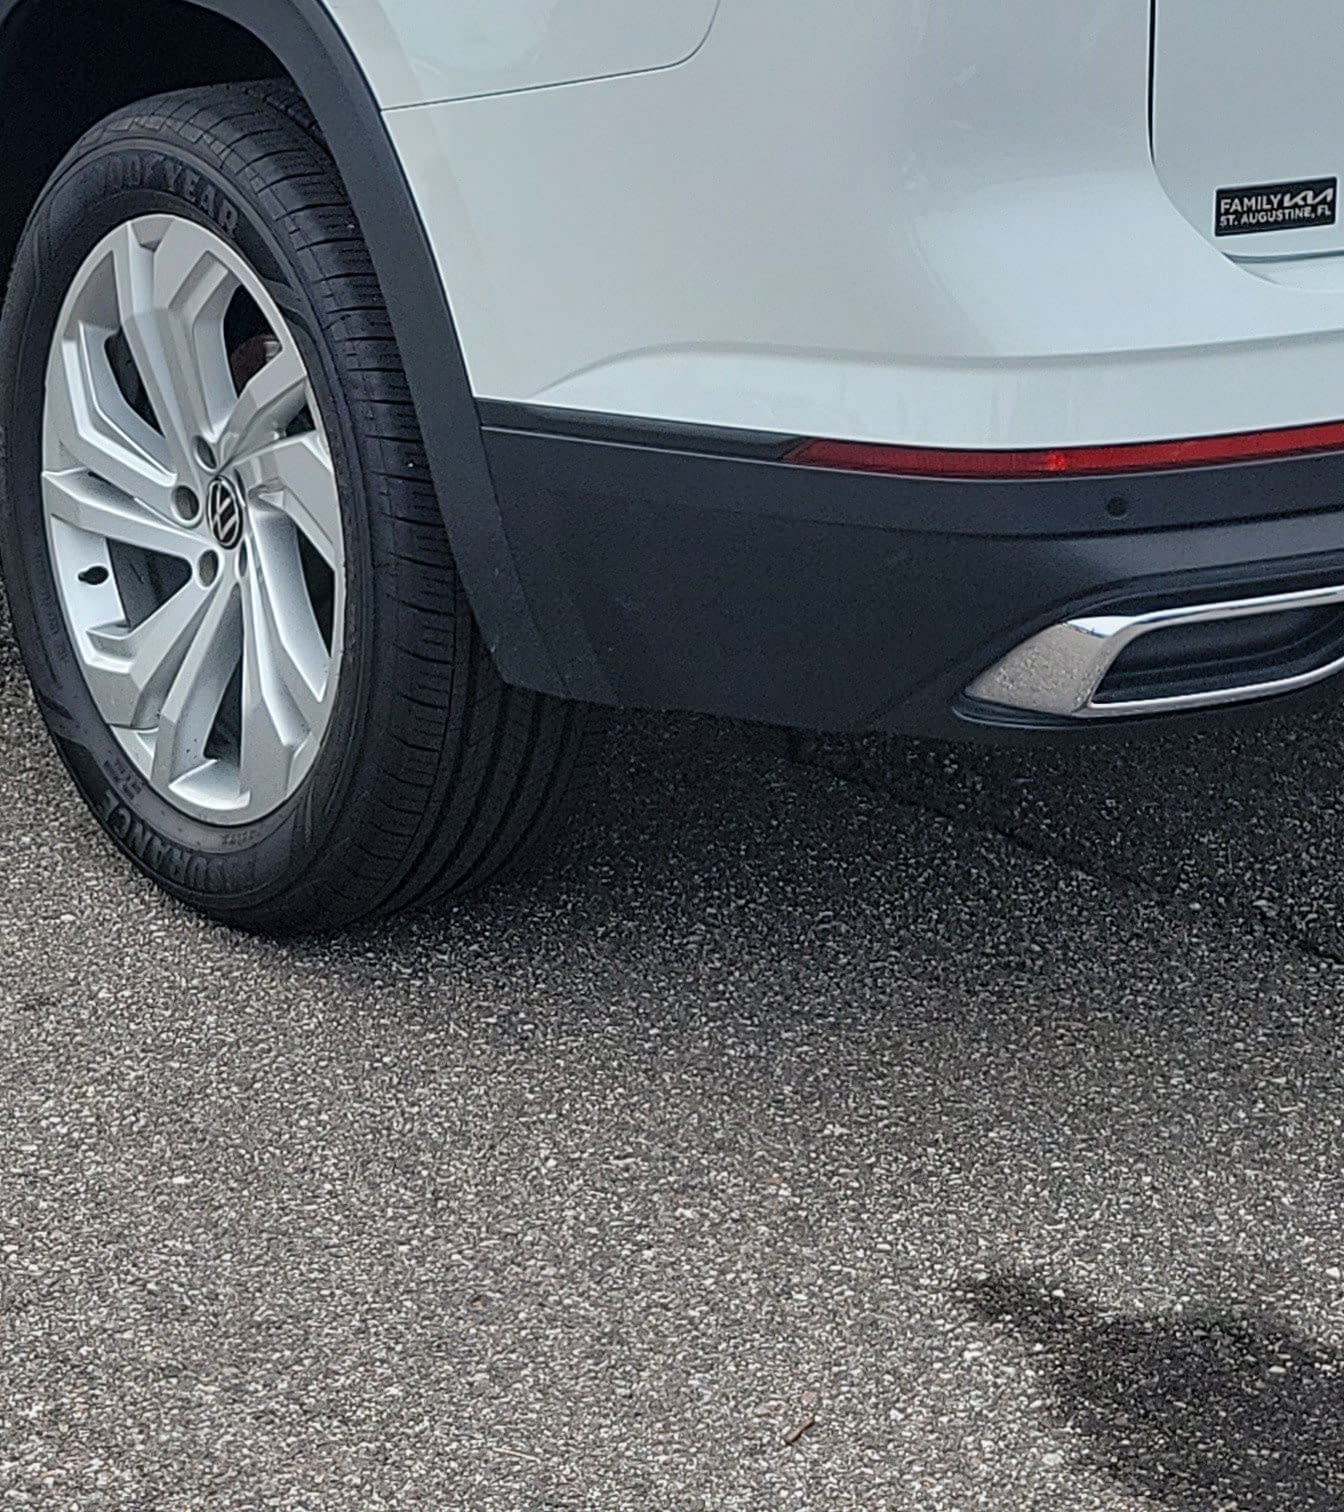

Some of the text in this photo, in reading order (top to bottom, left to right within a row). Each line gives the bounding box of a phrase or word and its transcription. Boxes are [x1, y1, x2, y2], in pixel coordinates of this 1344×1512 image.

[1220, 192, 1282, 214] FAMILY
[1219, 204, 1332, 227] ST. AUGUSTINE, FL
